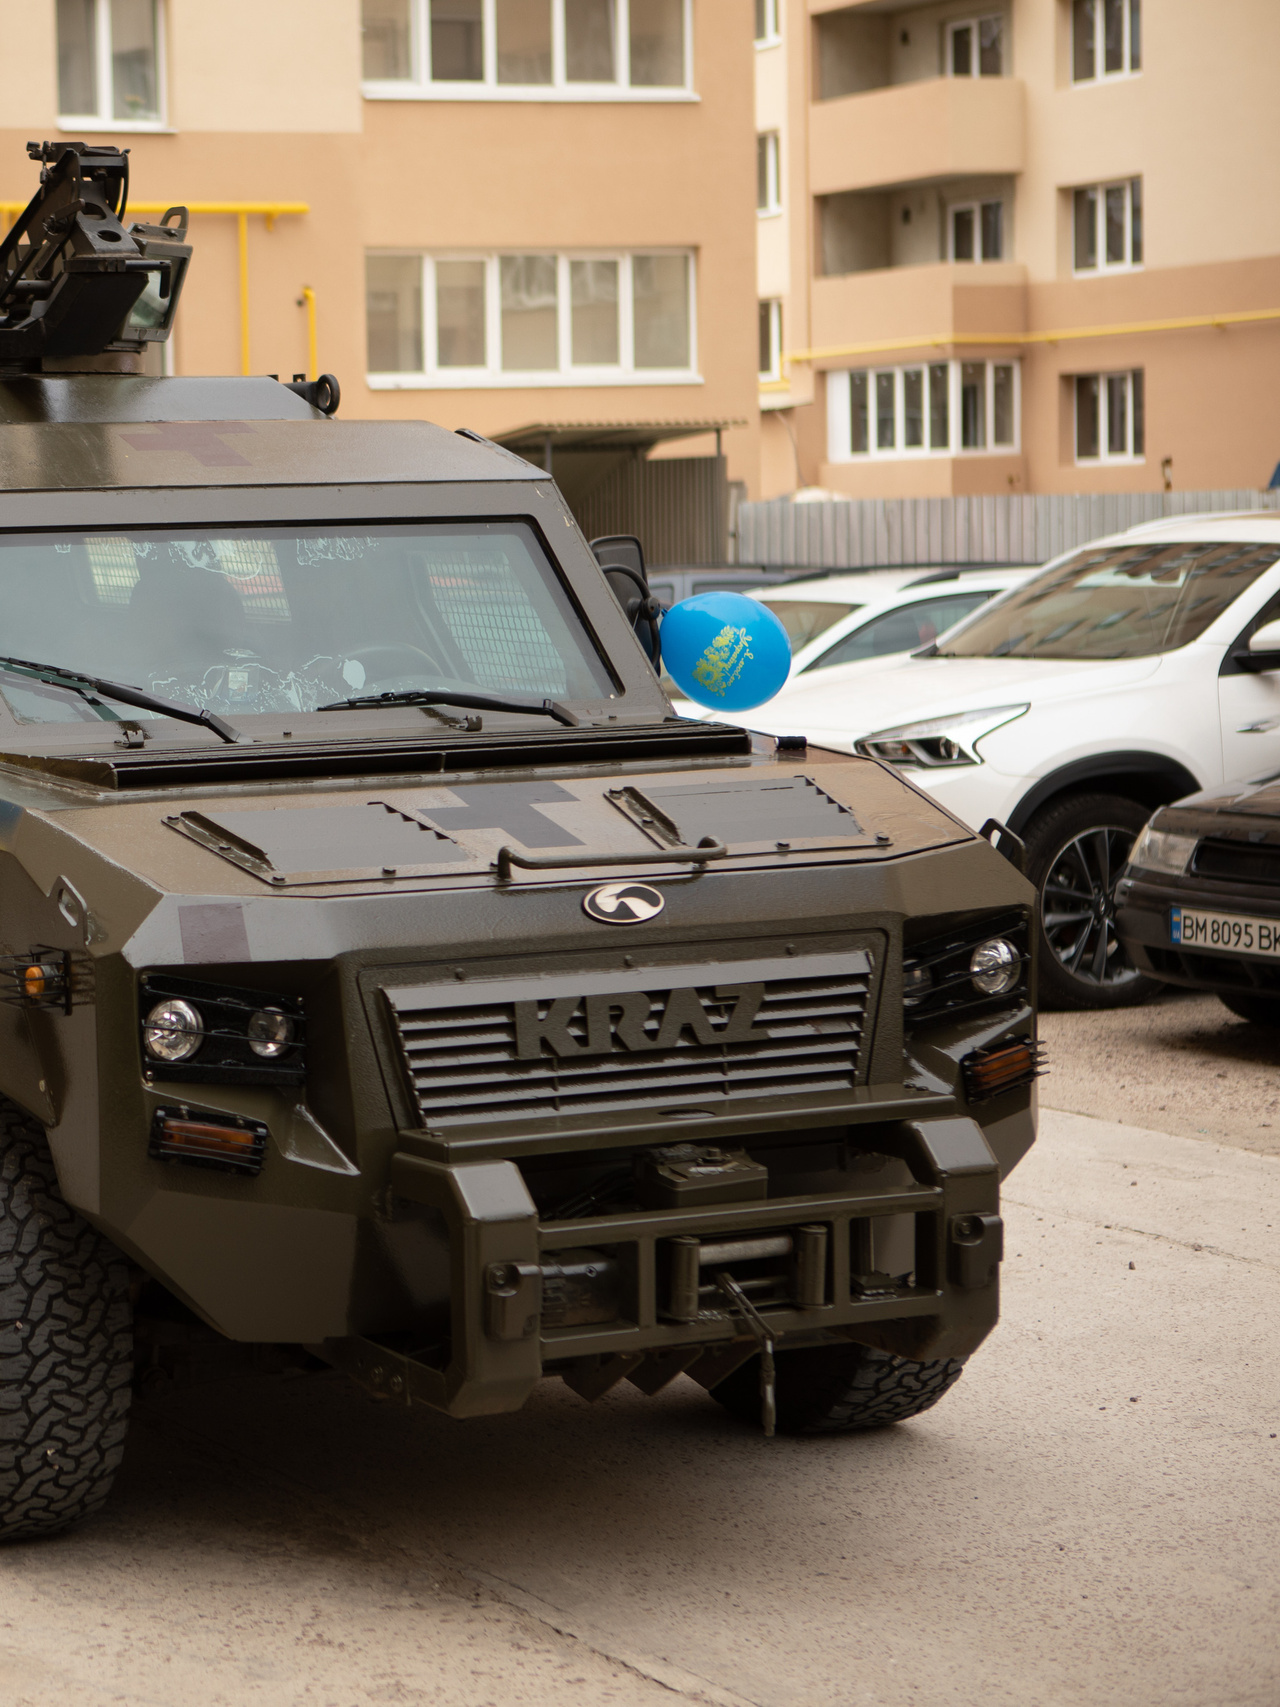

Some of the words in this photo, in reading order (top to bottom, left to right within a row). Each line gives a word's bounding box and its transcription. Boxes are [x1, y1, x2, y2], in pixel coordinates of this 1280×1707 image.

[1183, 916, 1207, 943] BM
[1211, 920, 1253, 948] 8095
[514, 982, 770, 1061] KRAZ
